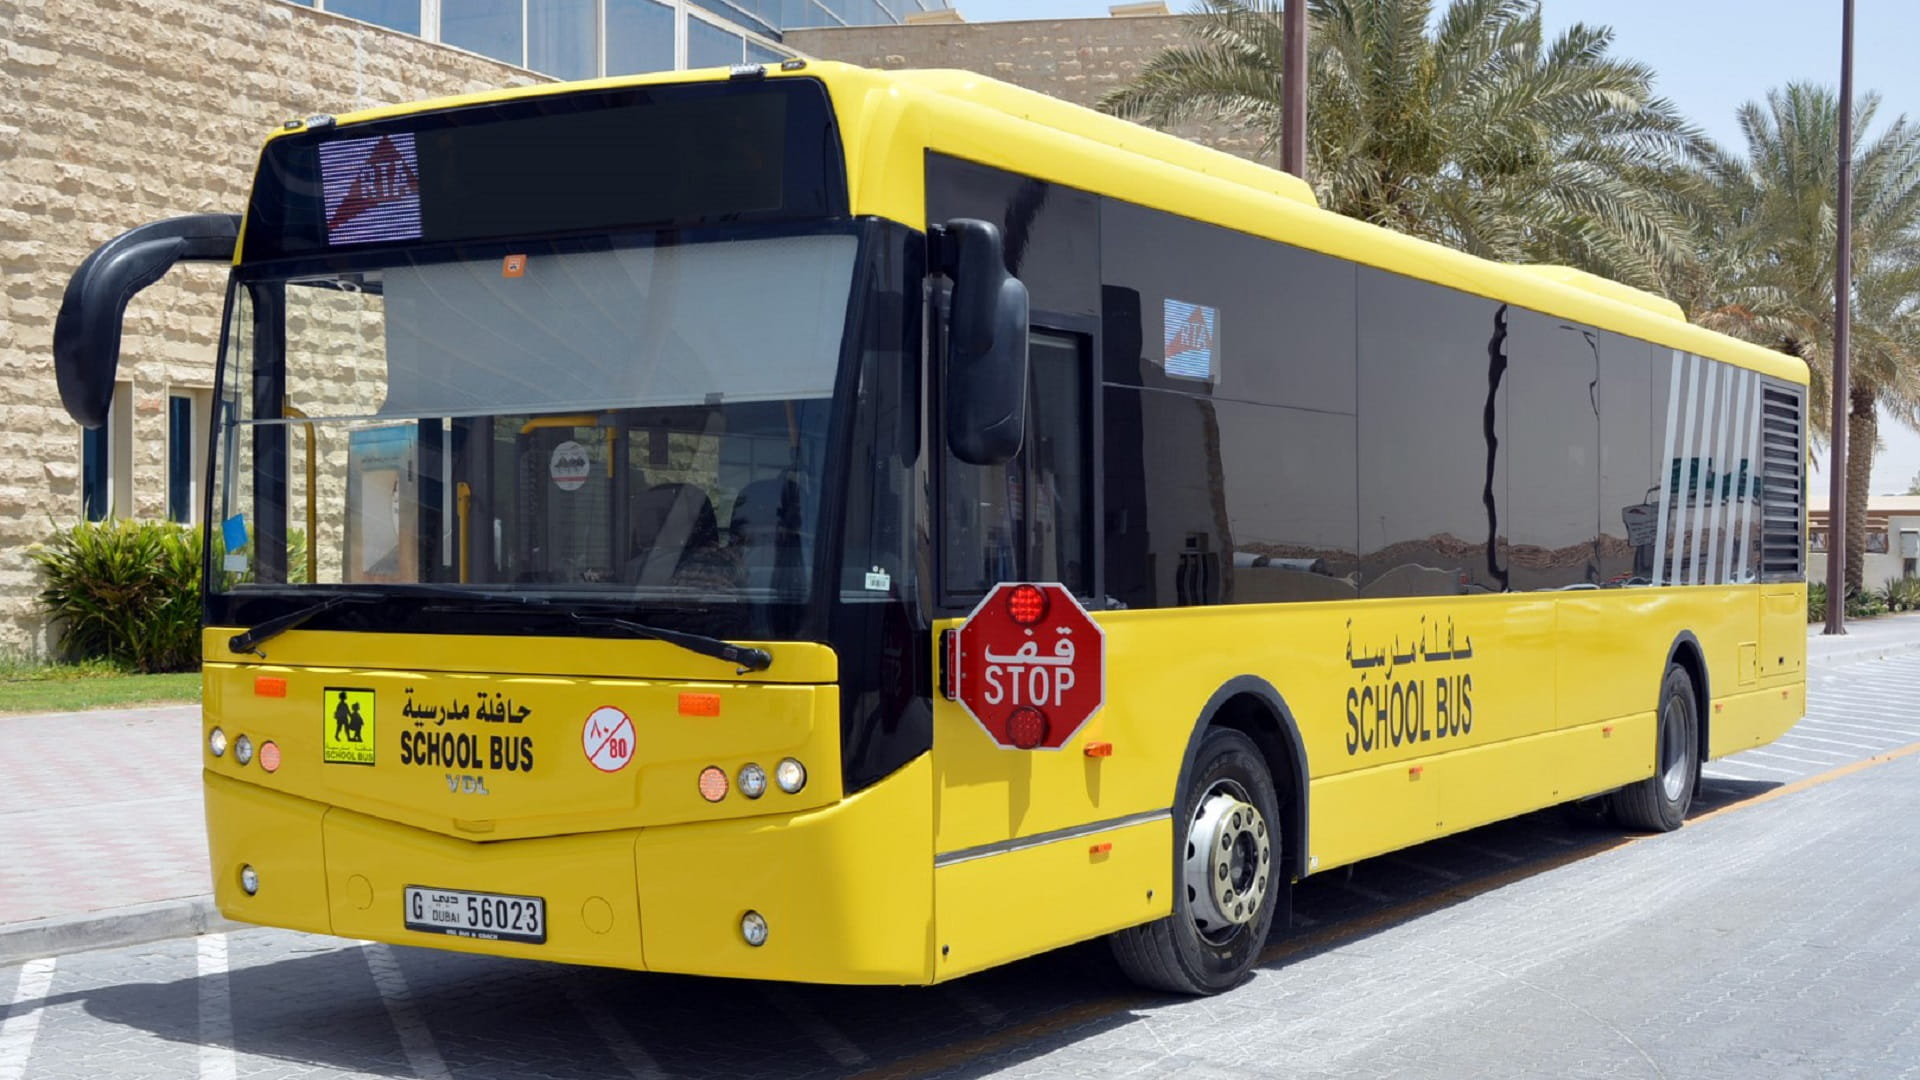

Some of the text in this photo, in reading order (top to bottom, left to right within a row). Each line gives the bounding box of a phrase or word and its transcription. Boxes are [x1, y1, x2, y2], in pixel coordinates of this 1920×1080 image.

[984, 665, 1076, 707] STOP
[402, 687, 532, 727] حافلة مدرسية
[1346, 673, 1473, 756] SCHOOL BUS
[326, 750, 374, 762] SCHOOL BUS
[400, 730, 533, 773] SCHOOL BUS
[610, 738, 628, 758] 80
[445, 773, 490, 795] VDL
[412, 891, 538, 932] G 56023
[432, 909, 460, 923] DUBAI
